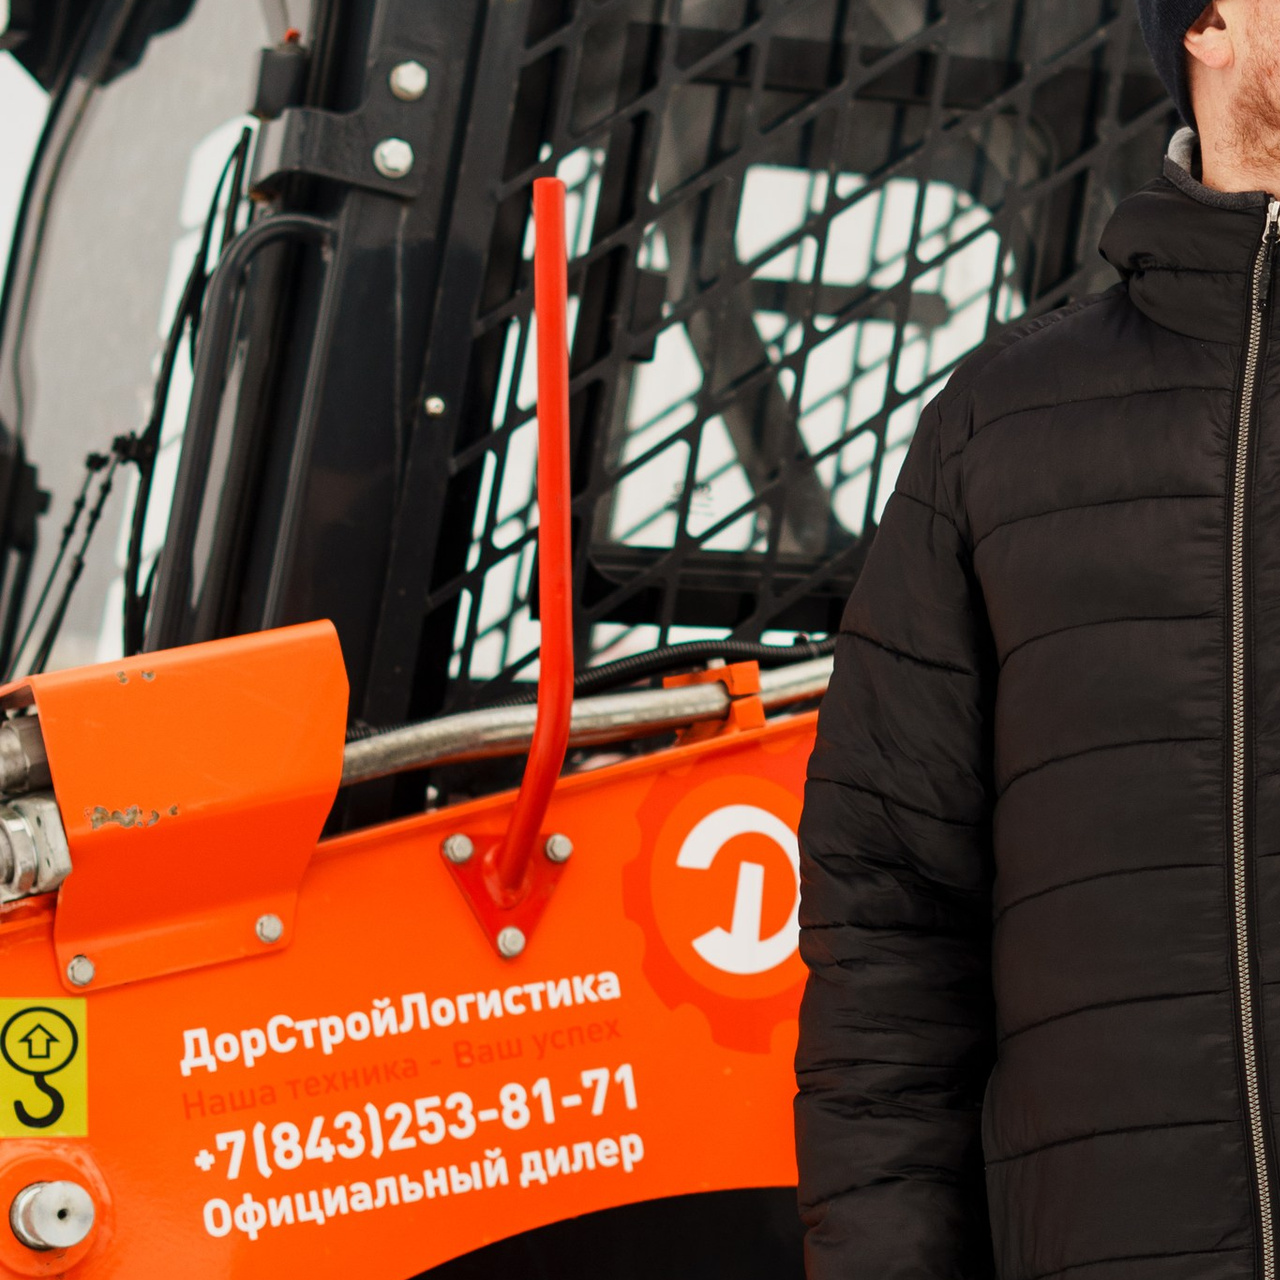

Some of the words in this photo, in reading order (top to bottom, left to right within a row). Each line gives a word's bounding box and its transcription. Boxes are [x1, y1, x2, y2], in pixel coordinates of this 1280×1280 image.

[179, 970, 621, 1077] ДорСтройЛогистика
[181, 1083, 278, 1121] Наша
[285, 1057, 420, 1101] техника
[453, 1037, 524, 1069] Ваш
[532, 1018, 622, 1061] успех
[194, 1063, 638, 1180] +7(843)253-81-71
[202, 1147, 509, 1241] Официальный
[519, 1132, 645, 1188] дилер
